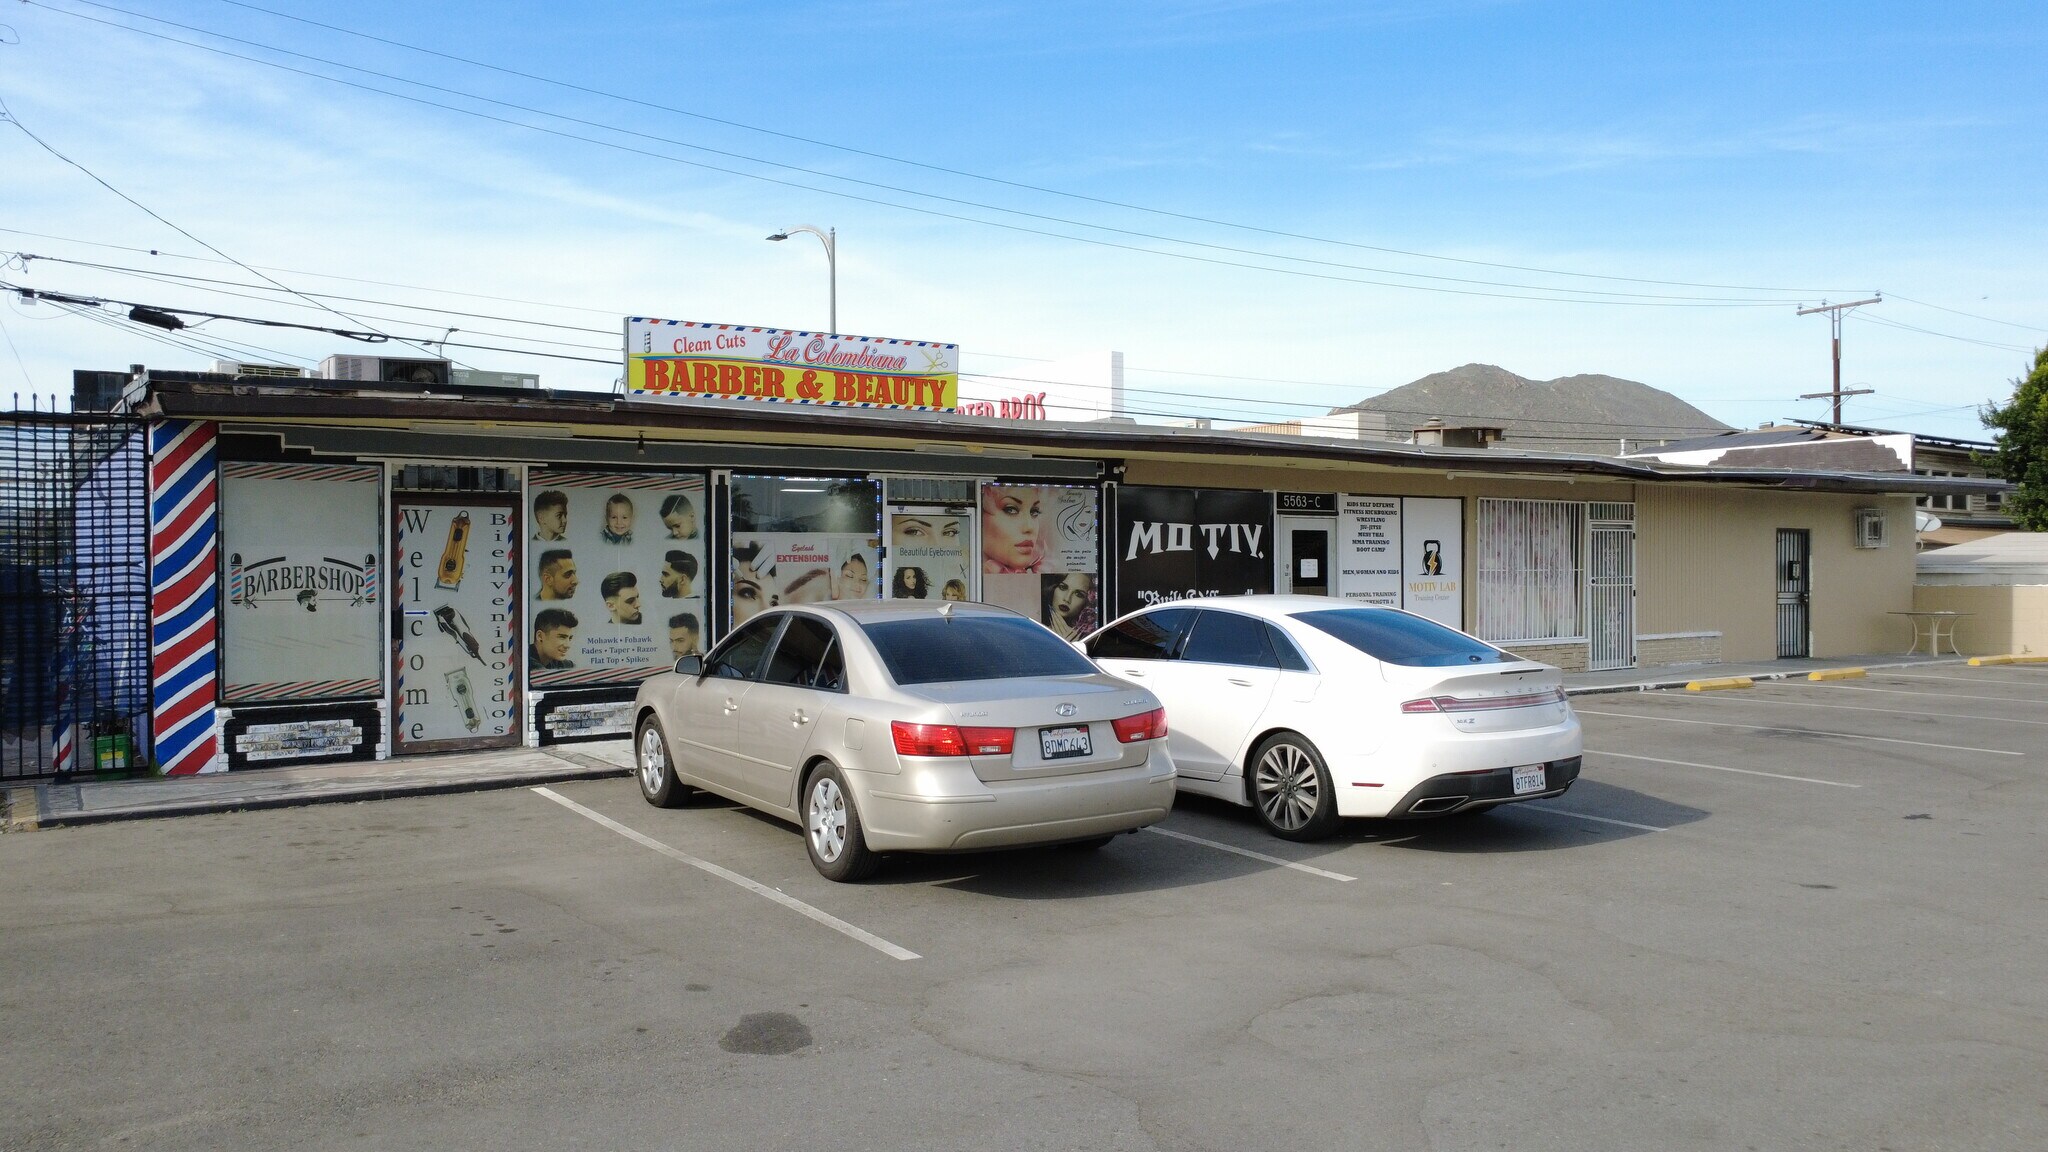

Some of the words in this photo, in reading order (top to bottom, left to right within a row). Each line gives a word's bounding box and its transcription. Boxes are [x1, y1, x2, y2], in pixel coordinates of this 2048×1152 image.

[673, 336, 712, 354] Clean
[716, 334, 746, 349] Cuts
[762, 335, 800, 363] La
[803, 336, 908, 371] Colombiana
[643, 359, 785, 397] BARBER
[796, 369, 823, 399] &
[834, 372, 947, 407] BEAUTY
[1283, 495, 1321, 508] 5563-C
[899, 547, 928, 557] Beautiful
[776, 554, 829, 563] EXTENSIONS
[244, 565, 365, 598] BARBERSHOP
[1440, 582, 1456, 592] LAB
[587, 637, 618, 645] Mohawk
[581, 647, 602, 655] Fades
[609, 647, 630, 655] Taper
[590, 657, 605, 665] Flat
[607, 657, 620, 665] Top
[625, 656, 650, 664] Spikes
